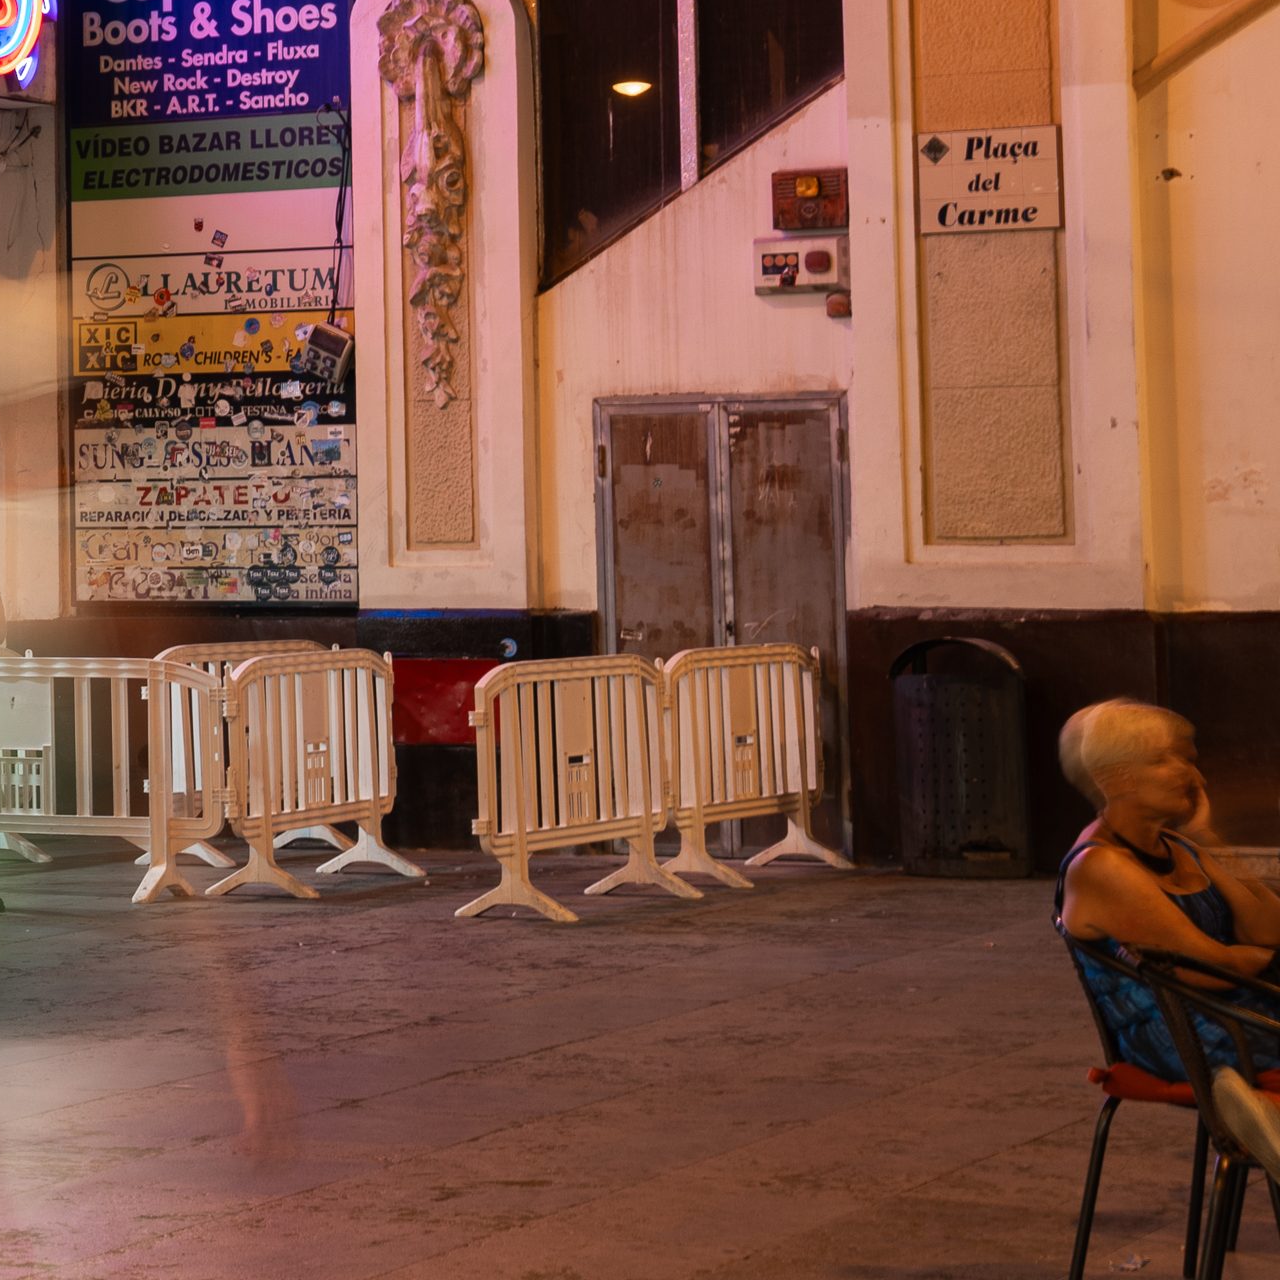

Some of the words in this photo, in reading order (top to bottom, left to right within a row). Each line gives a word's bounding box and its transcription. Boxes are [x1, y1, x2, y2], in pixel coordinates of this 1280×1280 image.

[82, 11, 177, 47] Boots
[190, 2, 219, 40] &
[99, 54, 163, 74] Dantes
[181, 44, 248, 68] Sendra
[267, 39, 319, 62] Fluxa
[113, 77, 158, 96] New
[163, 71, 208, 92] Rock
[226, 67, 300, 94] Destroy
[111, 100, 148, 118] BKR
[166, 94, 220, 115] A.R.T.
[239, 86, 309, 110] Sancho
[76, 134, 149, 160] VÍDEO
[159, 129, 241, 155] BAZAR
[250, 124, 345, 150] LLORET
[964, 135, 1039, 164] Plaça
[82, 157, 344, 191] ELECTRODOMESTICOS
[967, 172, 1000, 193] del
[937, 201, 1038, 227] Carme
[223, 294, 340, 310] IMOBILIARIA
[86, 326, 130, 344] XIC
[143, 352, 180, 367] ROA
[194, 349, 273, 366] CHILDREN'S
